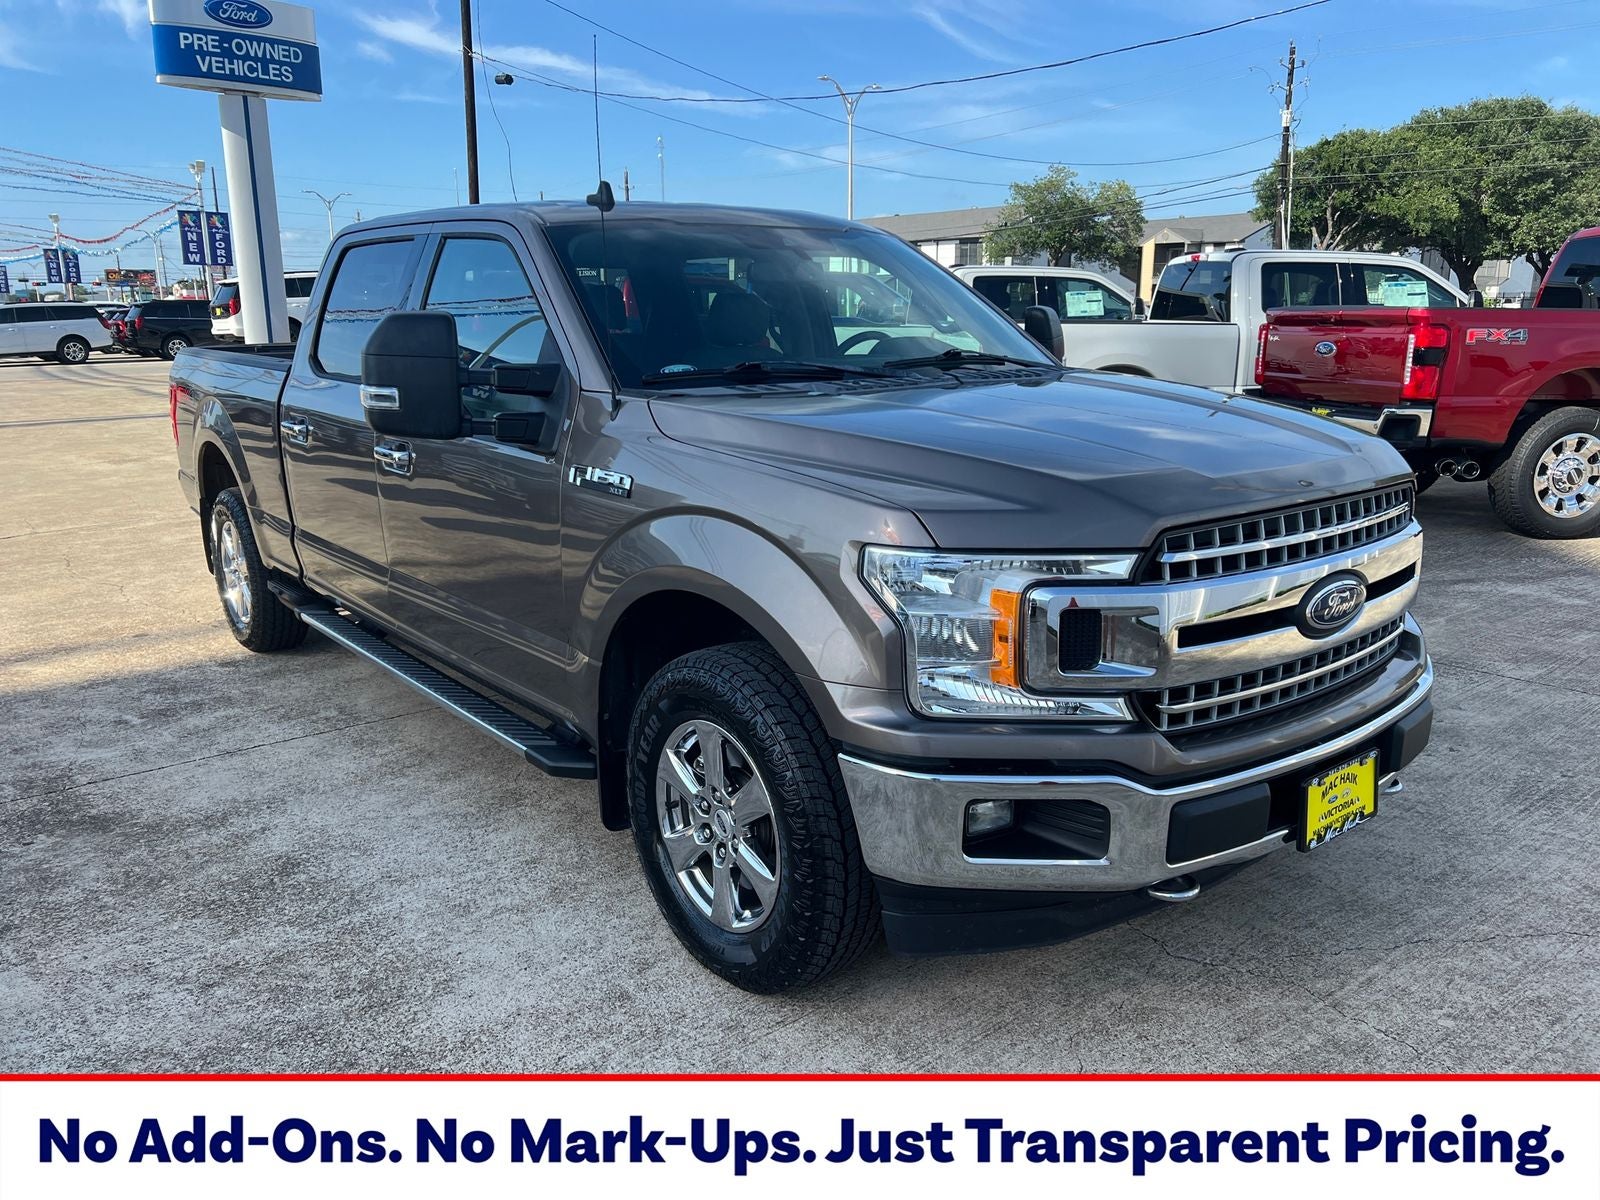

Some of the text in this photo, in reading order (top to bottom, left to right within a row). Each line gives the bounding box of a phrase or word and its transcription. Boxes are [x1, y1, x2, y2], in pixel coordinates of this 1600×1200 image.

[219, 1, 258, 22] Ford
[196, 55, 293, 82] VEHICLES
[187, 231, 200, 263] NEW
[215, 233, 226, 264] FORD
[1466, 328, 1528, 345] FX4
[609, 487, 622, 495] XLT
[1324, 589, 1356, 620] Ford
[1321, 776, 1339, 802] MAC
[1339, 772, 1358, 786] HAIK
